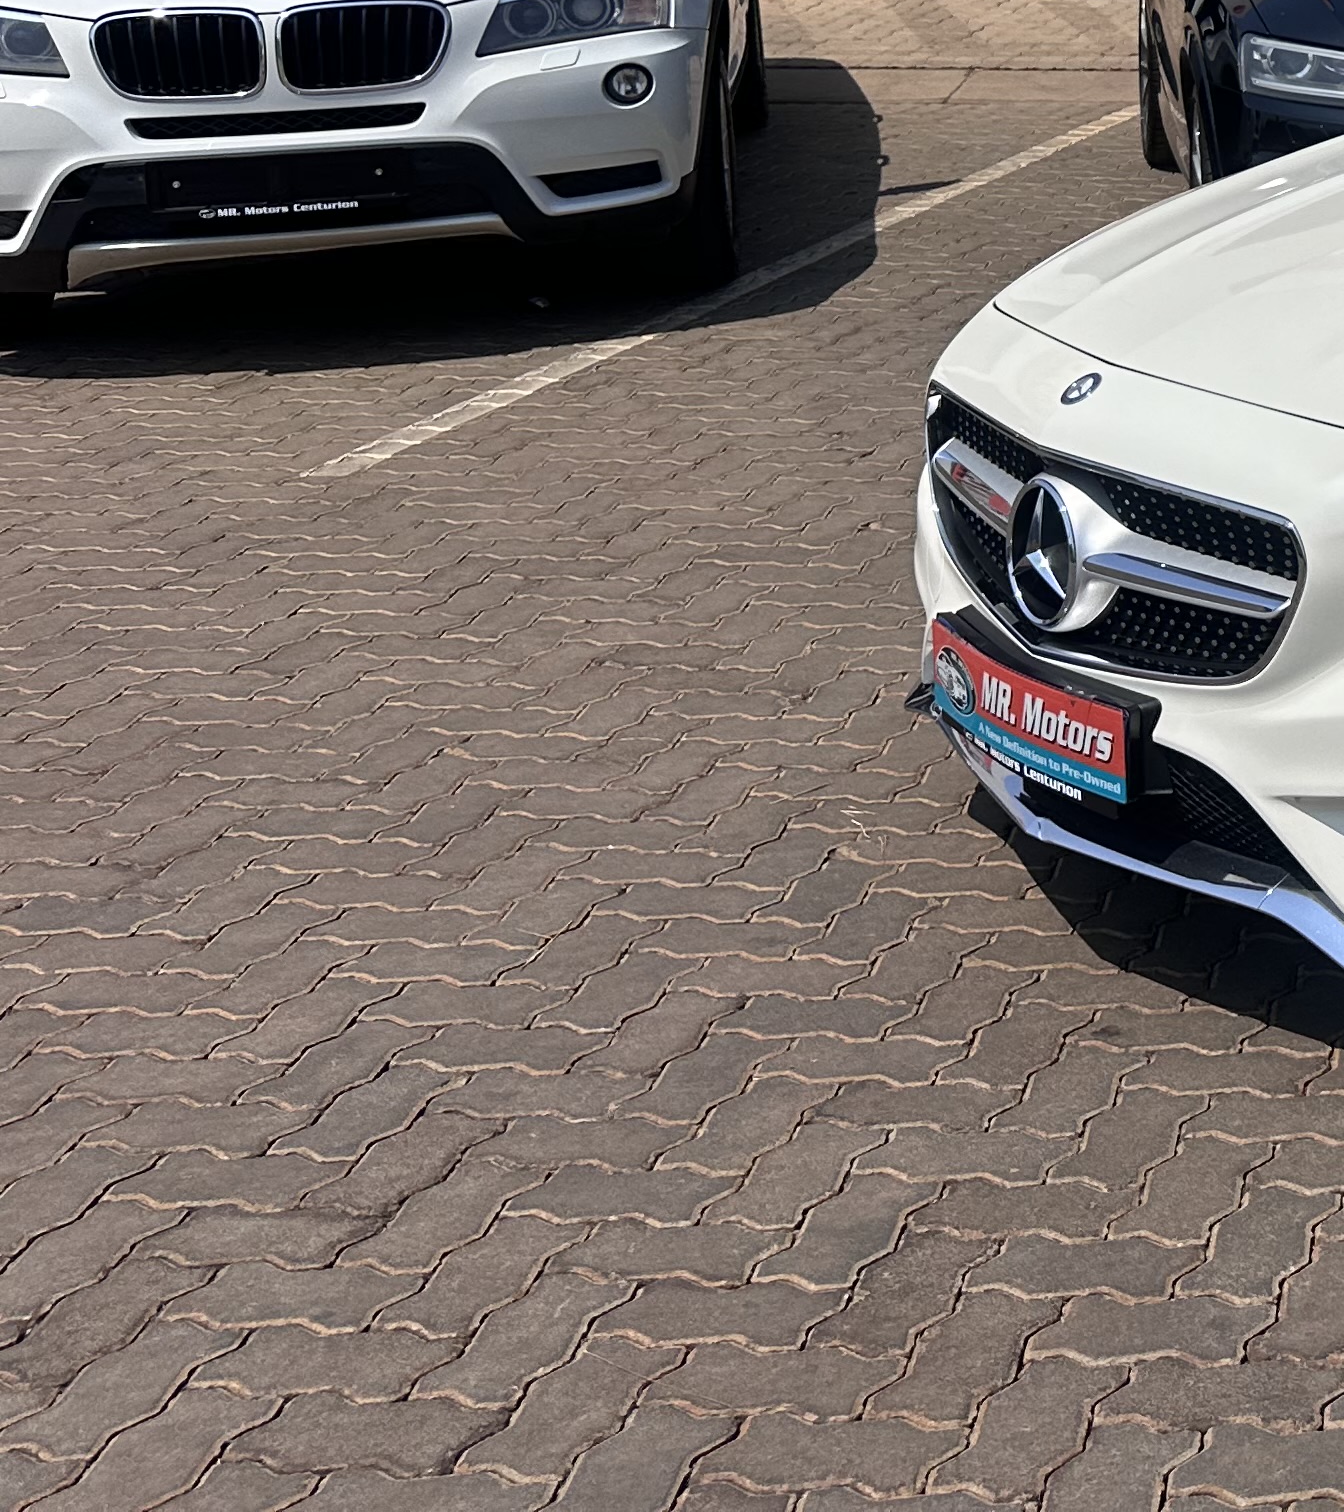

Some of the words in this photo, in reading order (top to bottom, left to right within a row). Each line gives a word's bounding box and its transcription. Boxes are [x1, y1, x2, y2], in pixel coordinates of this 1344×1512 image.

[217, 207, 241, 218] MR.
[244, 204, 289, 216] Motors
[293, 200, 359, 212] Centurion
[980, 671, 1017, 726] MR.
[1020, 692, 1114, 763] Motors
[1002, 735, 1047, 767] Definition
[1049, 757, 1061, 772] to
[1062, 762, 1121, 795] Pre-Owned
